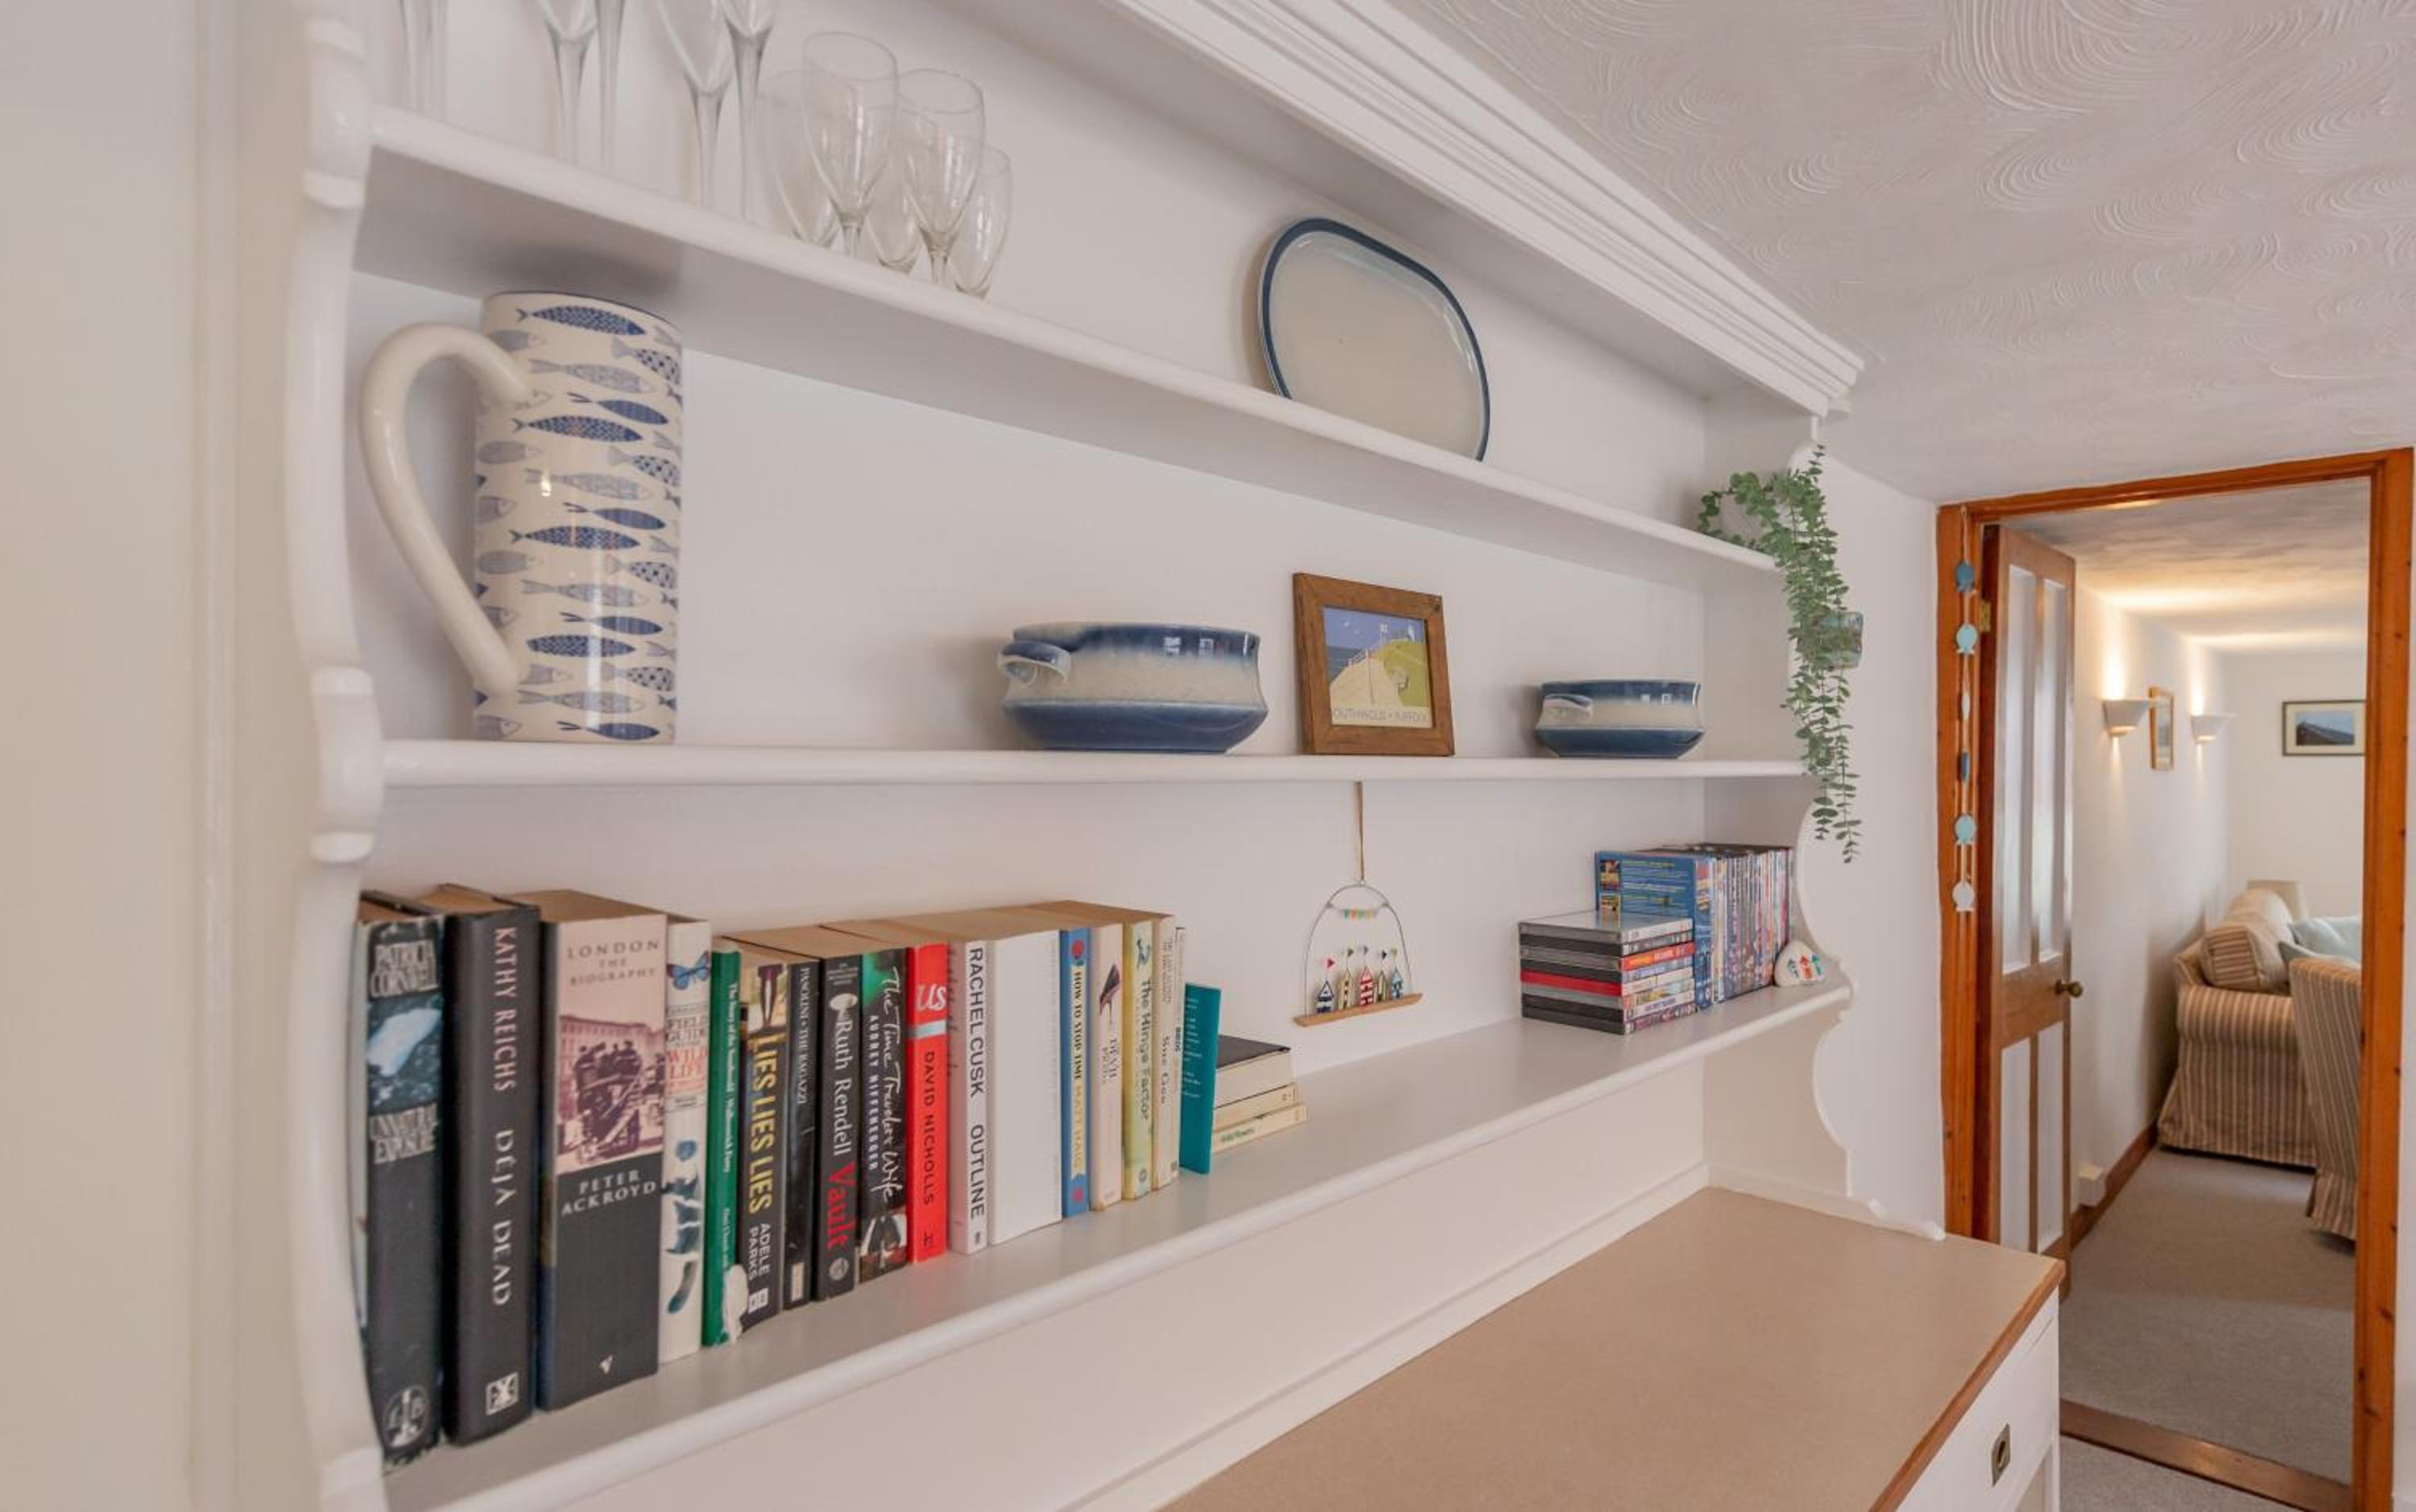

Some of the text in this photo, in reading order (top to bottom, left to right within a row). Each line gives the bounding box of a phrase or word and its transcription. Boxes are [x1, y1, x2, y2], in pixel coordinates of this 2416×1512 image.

[494, 927, 517, 998] KATHY
[566, 939, 660, 960] LONDON
[569, 968, 656, 986] BIOGRAPHY
[599, 957, 627, 969] THE
[880, 965, 901, 1015] The
[970, 947, 984, 1035] RACHEL
[494, 1010, 517, 1092] REICHS
[799, 1028, 810, 1051] THE
[883, 1006, 901, 1068] Time
[1074, 971, 1082, 1080] HOW TO STOP TIME
[1140, 979, 1152, 1122] The Hinge Factor
[869, 1015, 879, 1170] AUDREY NIFFENEGGER
[970, 1037, 985, 1098] CUSK
[747, 1031, 787, 1214] LIES LIES LIES
[826, 1018, 856, 1250] Ruth Rendell Vault
[923, 1051, 935, 1206] DAVID NICHOLLS
[561, 1180, 656, 1217] ACKROYD
[578, 1169, 642, 1195] PETER
[870, 1151, 904, 1204] Wife
[970, 1124, 985, 1221] OUTLINE
[492, 1220, 512, 1306] DEAD
[748, 1226, 759, 1281] PARKS
[759, 1222, 771, 1278] ADELE
